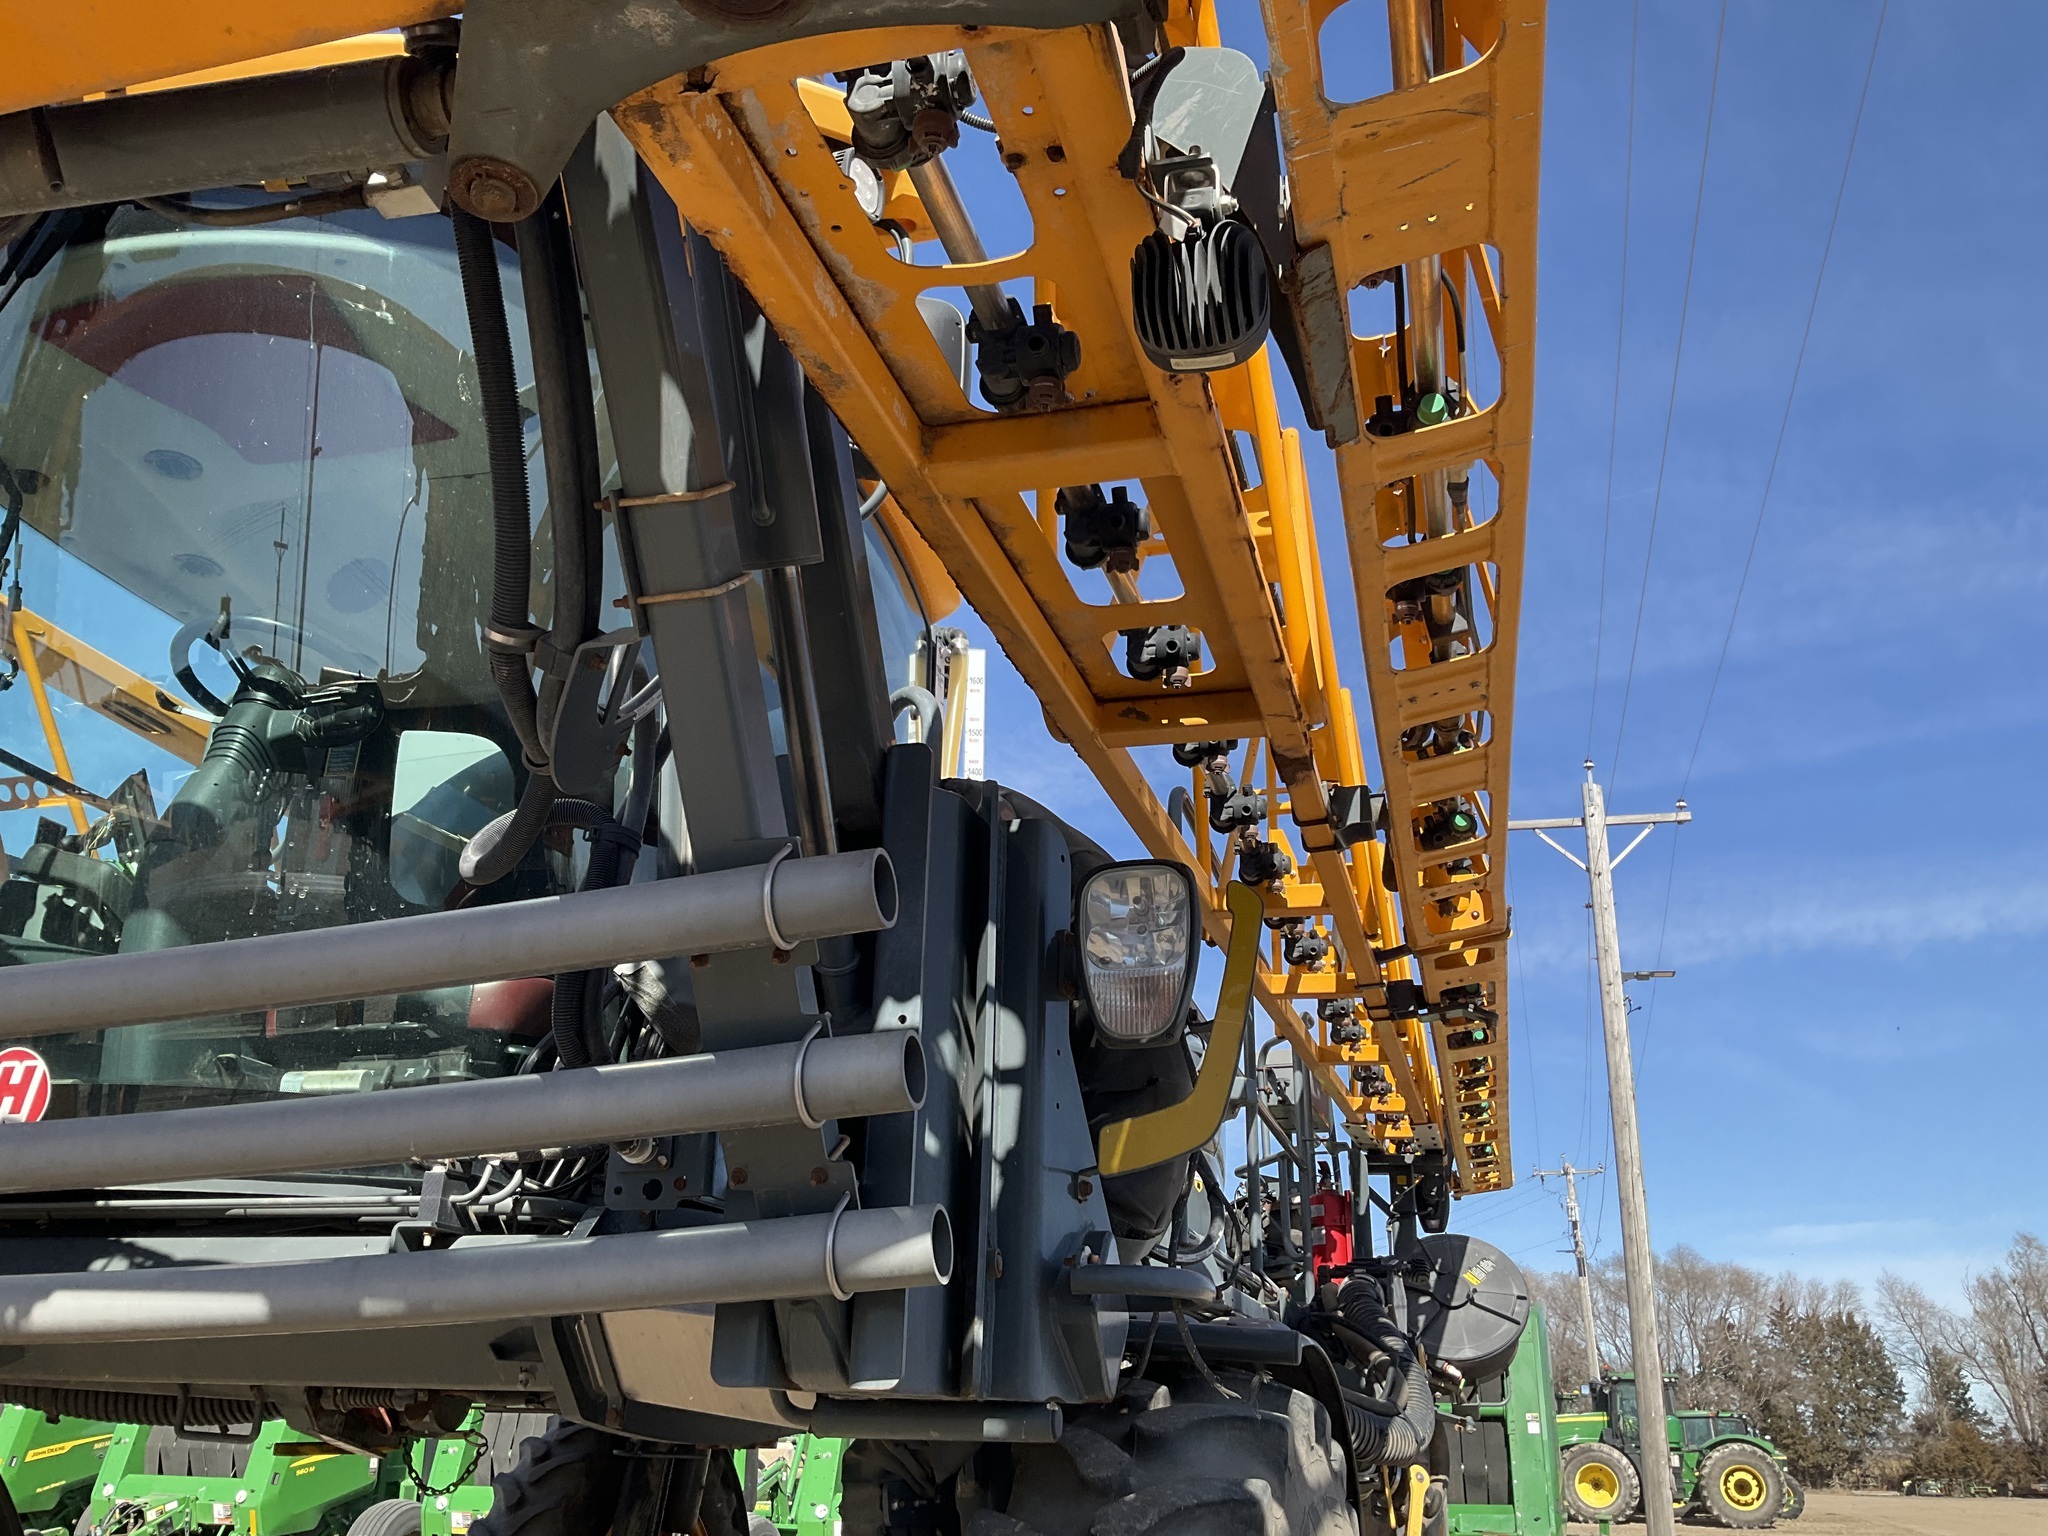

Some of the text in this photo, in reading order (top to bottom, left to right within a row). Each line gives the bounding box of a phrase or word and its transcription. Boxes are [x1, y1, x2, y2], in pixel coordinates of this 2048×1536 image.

[969, 677, 983, 685] 1600
[968, 728, 982, 737] 1500
[968, 768, 982, 776] 1400
[31, 1445, 66, 1458] JOHN DEERE
[296, 1468, 308, 1476] 560
